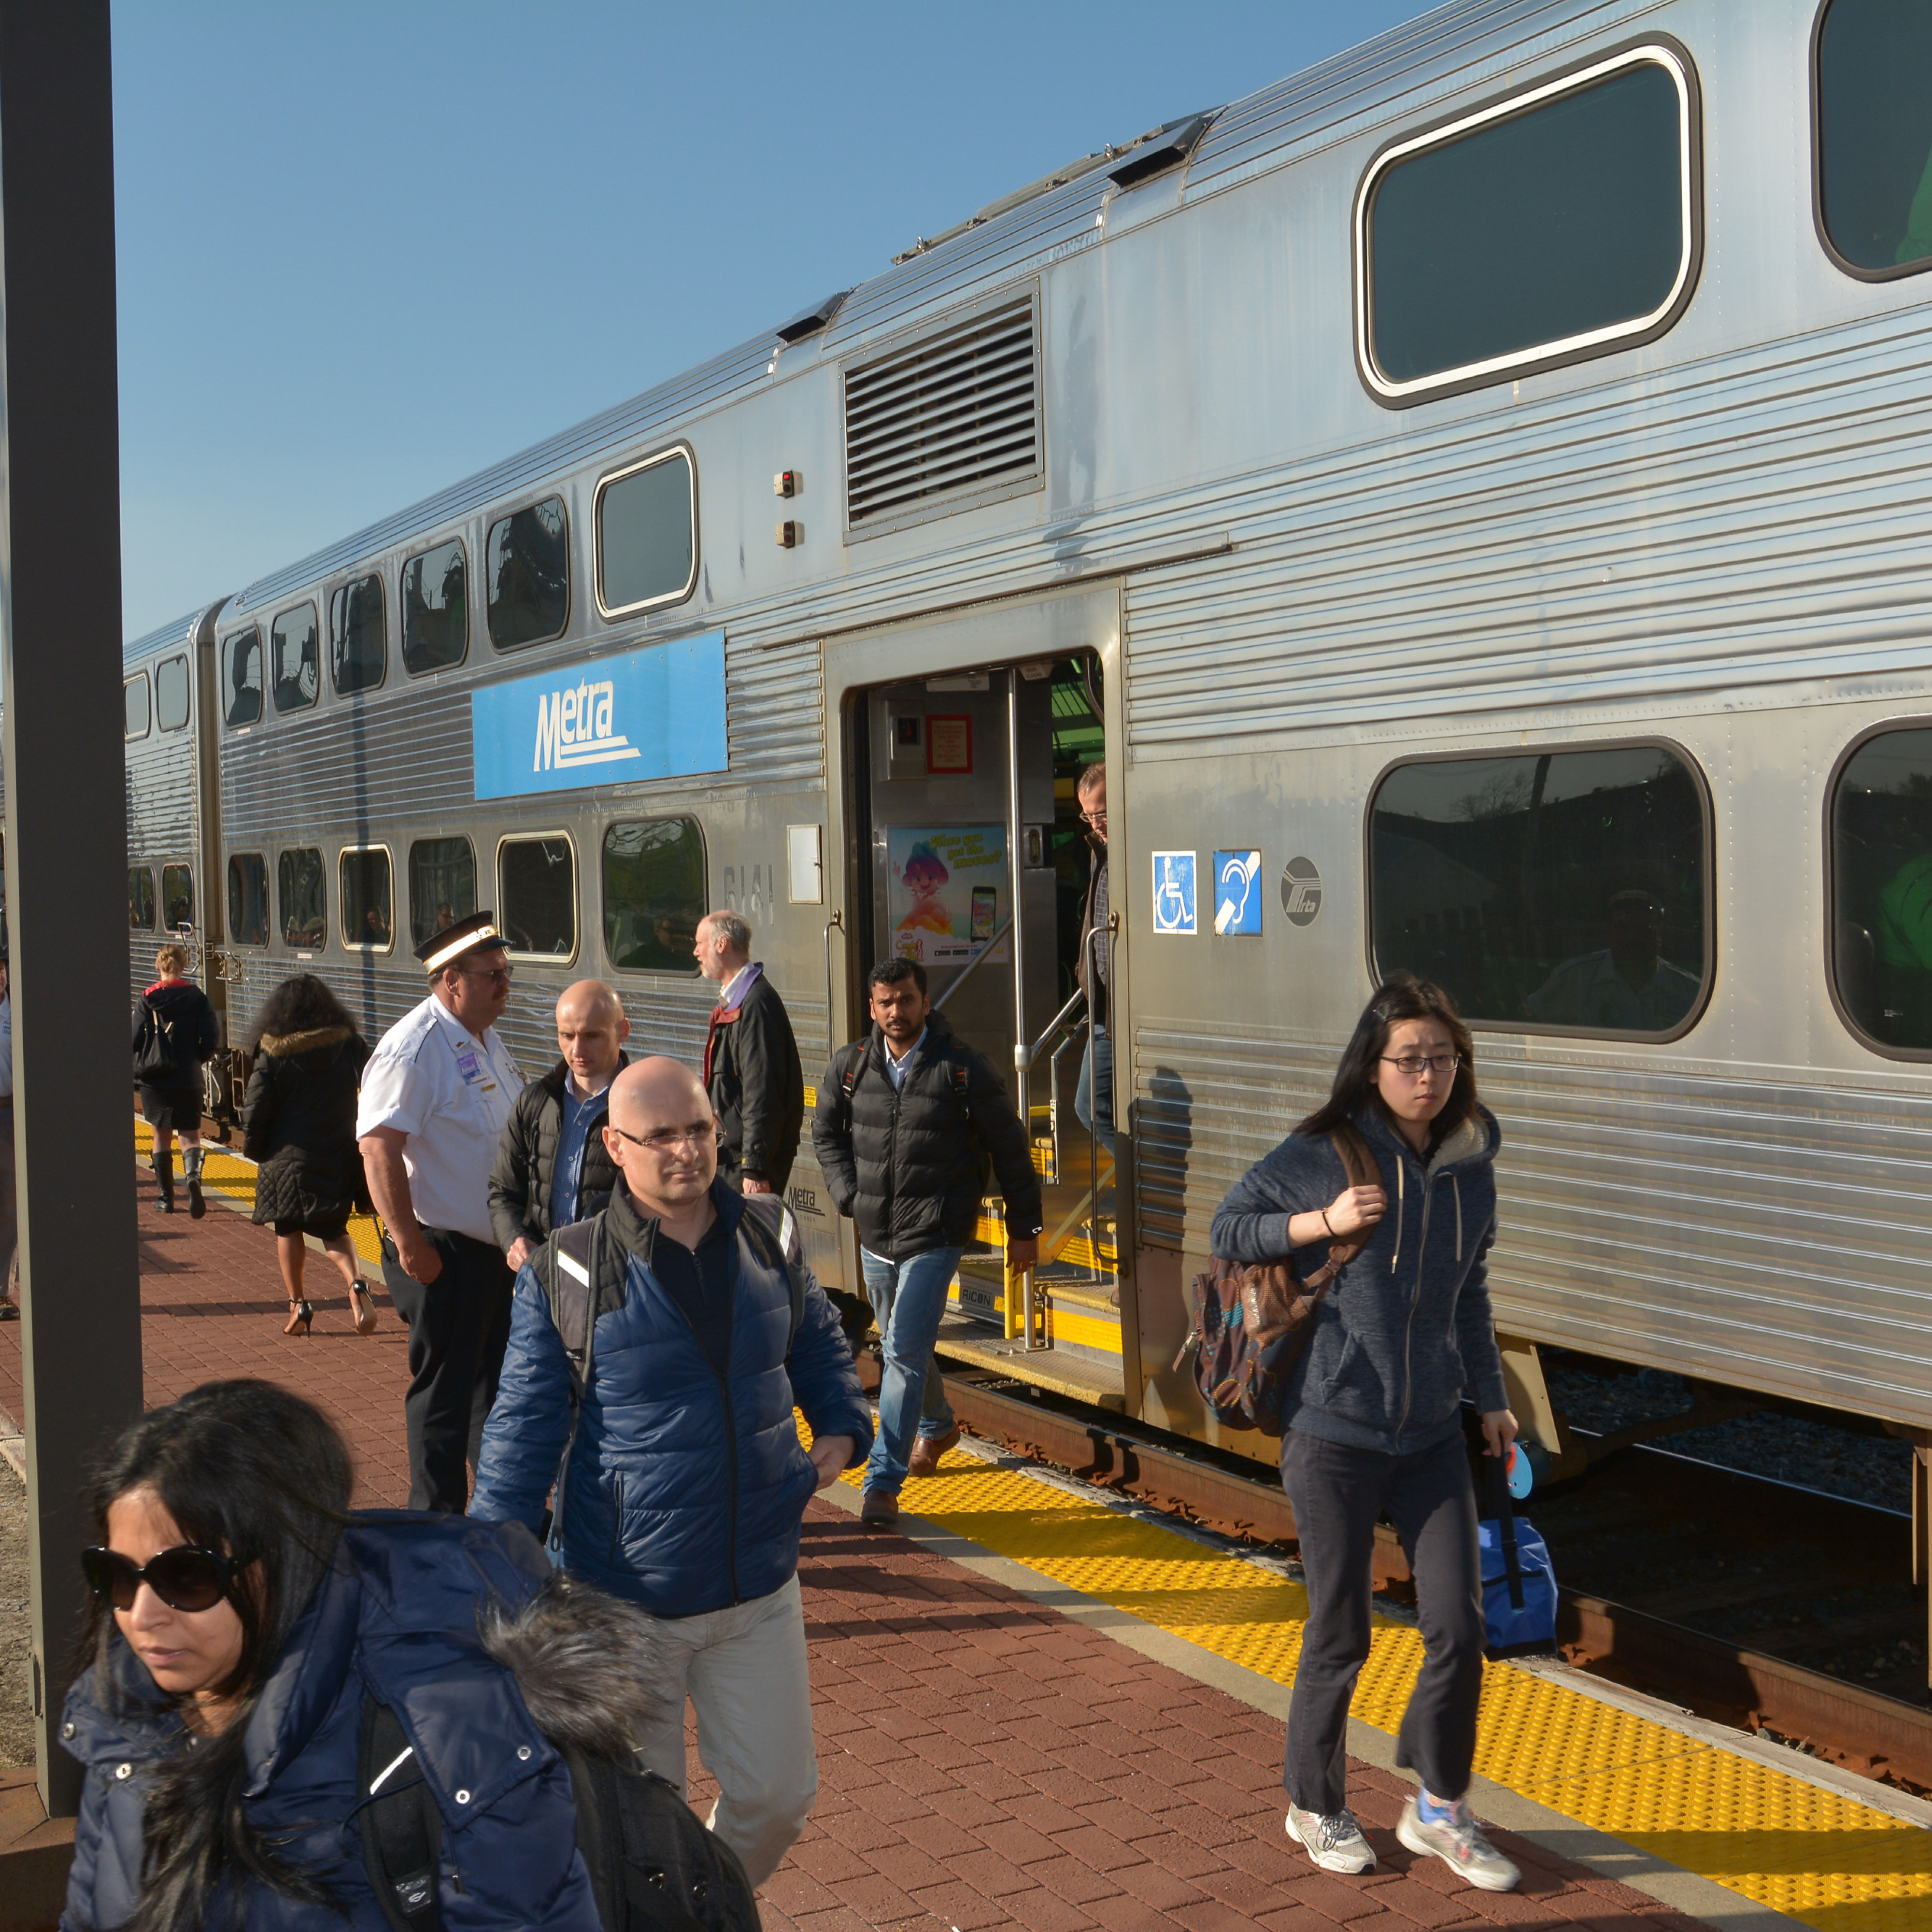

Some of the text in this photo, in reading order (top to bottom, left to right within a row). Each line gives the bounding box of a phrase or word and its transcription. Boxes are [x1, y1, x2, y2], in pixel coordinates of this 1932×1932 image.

[534, 678, 614, 772] Metra
[929, 833, 982, 850] Have you
[947, 843, 984, 861] got the
[954, 850, 1002, 869] moves?
[1300, 899, 1316, 913] rta
[788, 1187, 816, 1210] Metra
[962, 1289, 991, 1306] RICON
